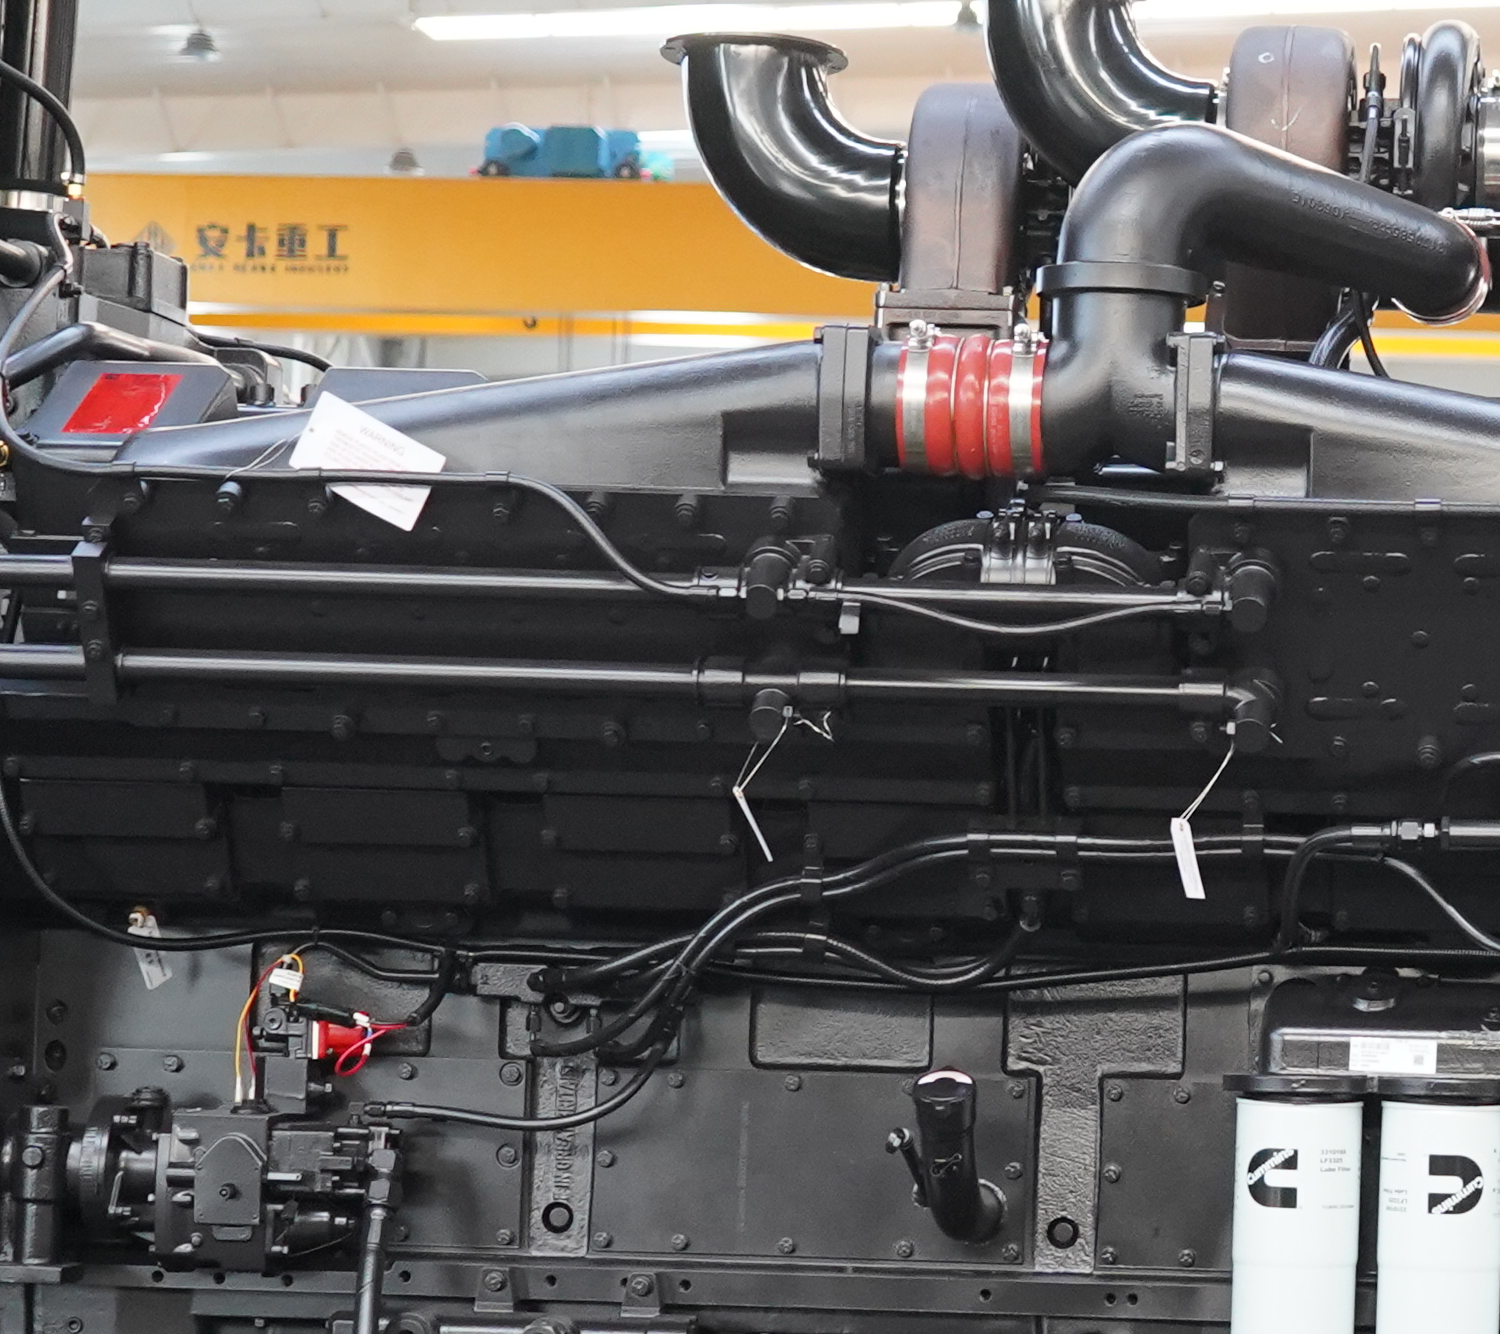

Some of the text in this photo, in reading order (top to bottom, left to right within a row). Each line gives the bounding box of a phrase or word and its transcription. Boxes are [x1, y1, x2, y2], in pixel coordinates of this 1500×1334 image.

[196, 222, 348, 260] 安卡重工
[360, 426, 405, 456] WARNING
[1247, 1148, 1294, 1185] Cummins
[1431, 1176, 1483, 1214] Cummins
